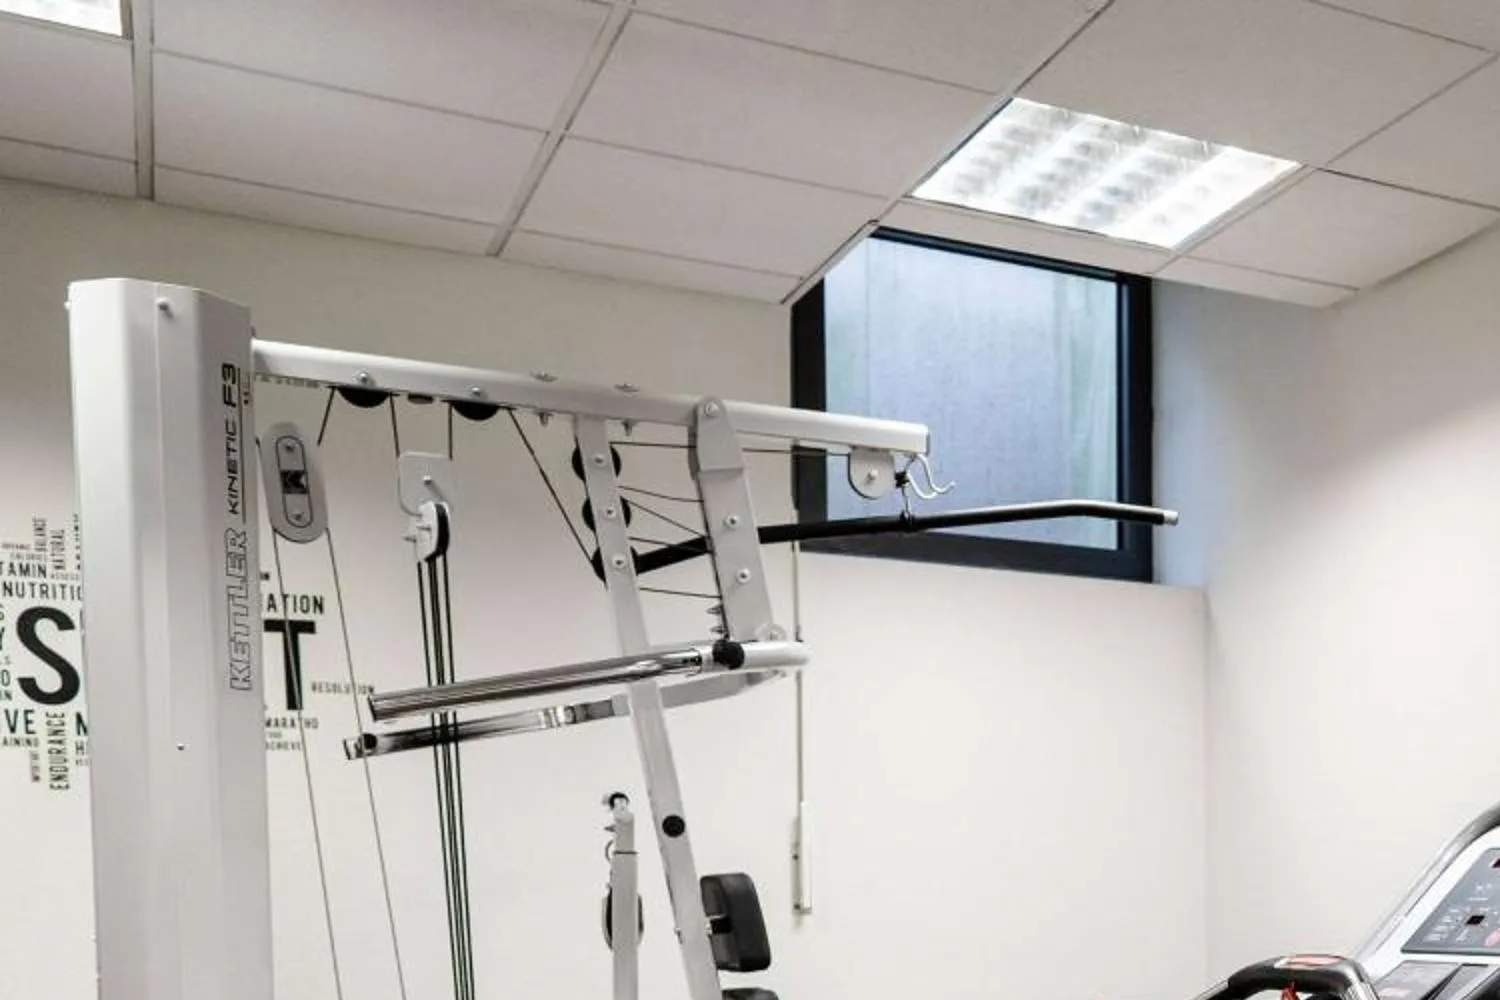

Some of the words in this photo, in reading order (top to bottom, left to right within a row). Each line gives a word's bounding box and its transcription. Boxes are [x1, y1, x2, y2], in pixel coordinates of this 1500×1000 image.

[221, 362, 237, 408] F3
[225, 420, 240, 515] KINETIC
[224, 527, 252, 691] KETTLER
[45, 711, 70, 791] ENDURANCE
